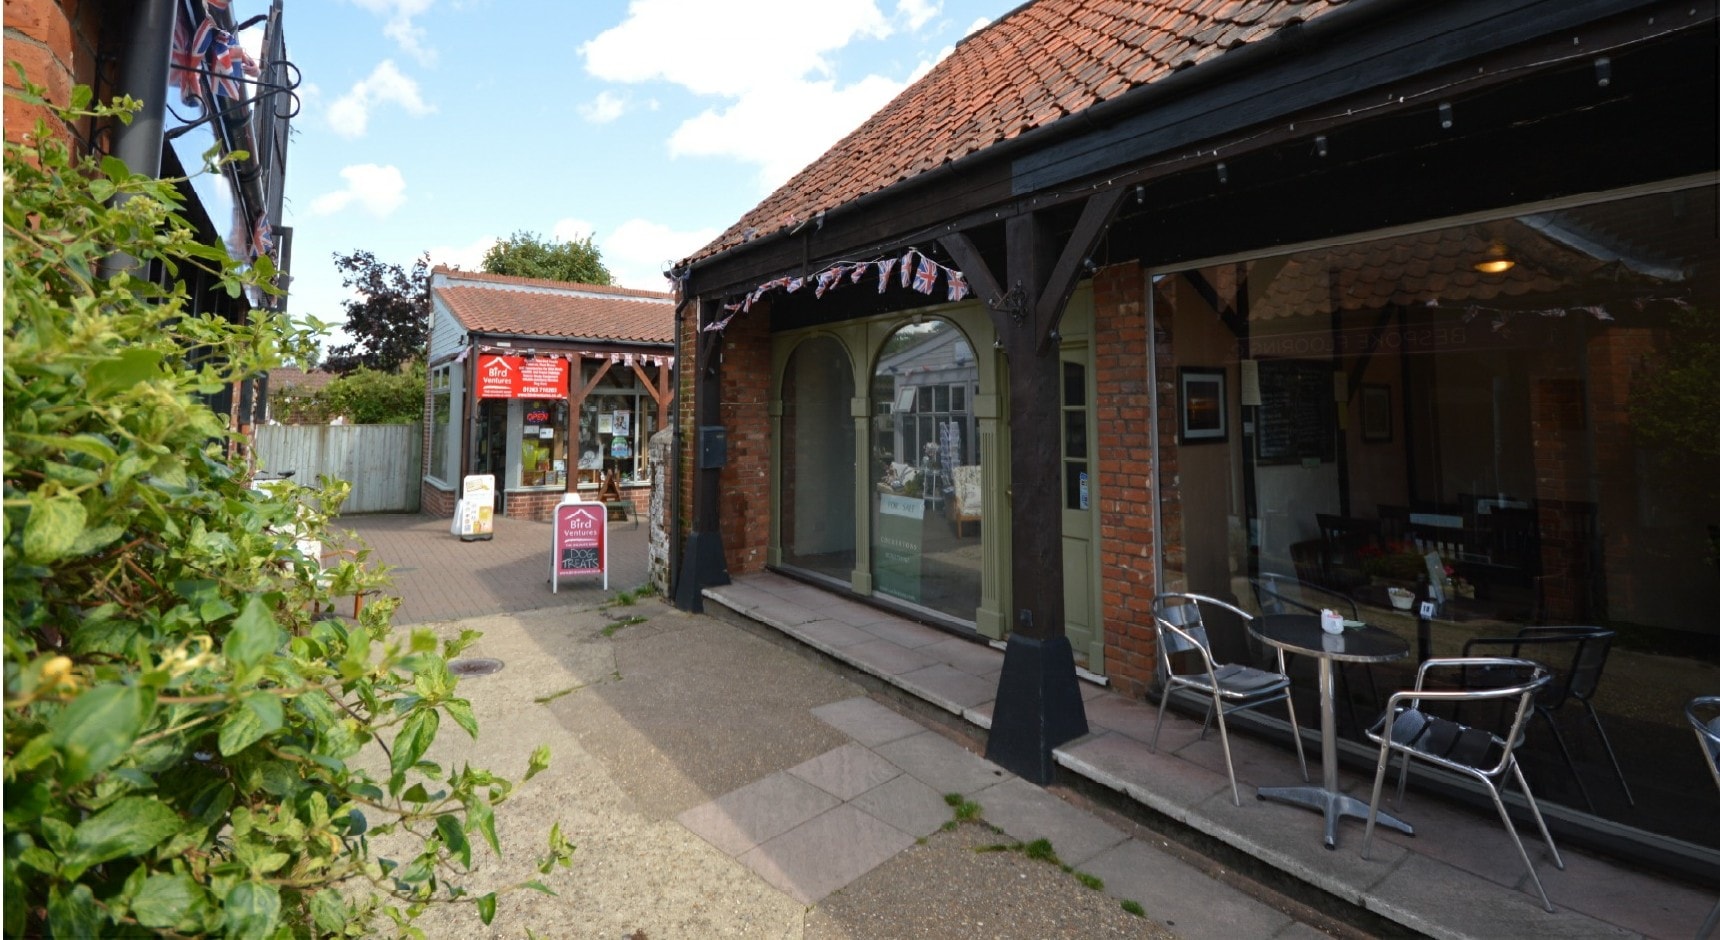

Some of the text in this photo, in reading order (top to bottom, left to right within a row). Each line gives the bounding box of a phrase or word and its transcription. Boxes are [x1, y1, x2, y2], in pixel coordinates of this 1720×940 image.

[489, 367, 508, 377] Bird
[526, 412, 549, 421] OPEN
[570, 519, 592, 529] Bird
[570, 549, 595, 559] DOG
[562, 558, 599, 569] TREATS
